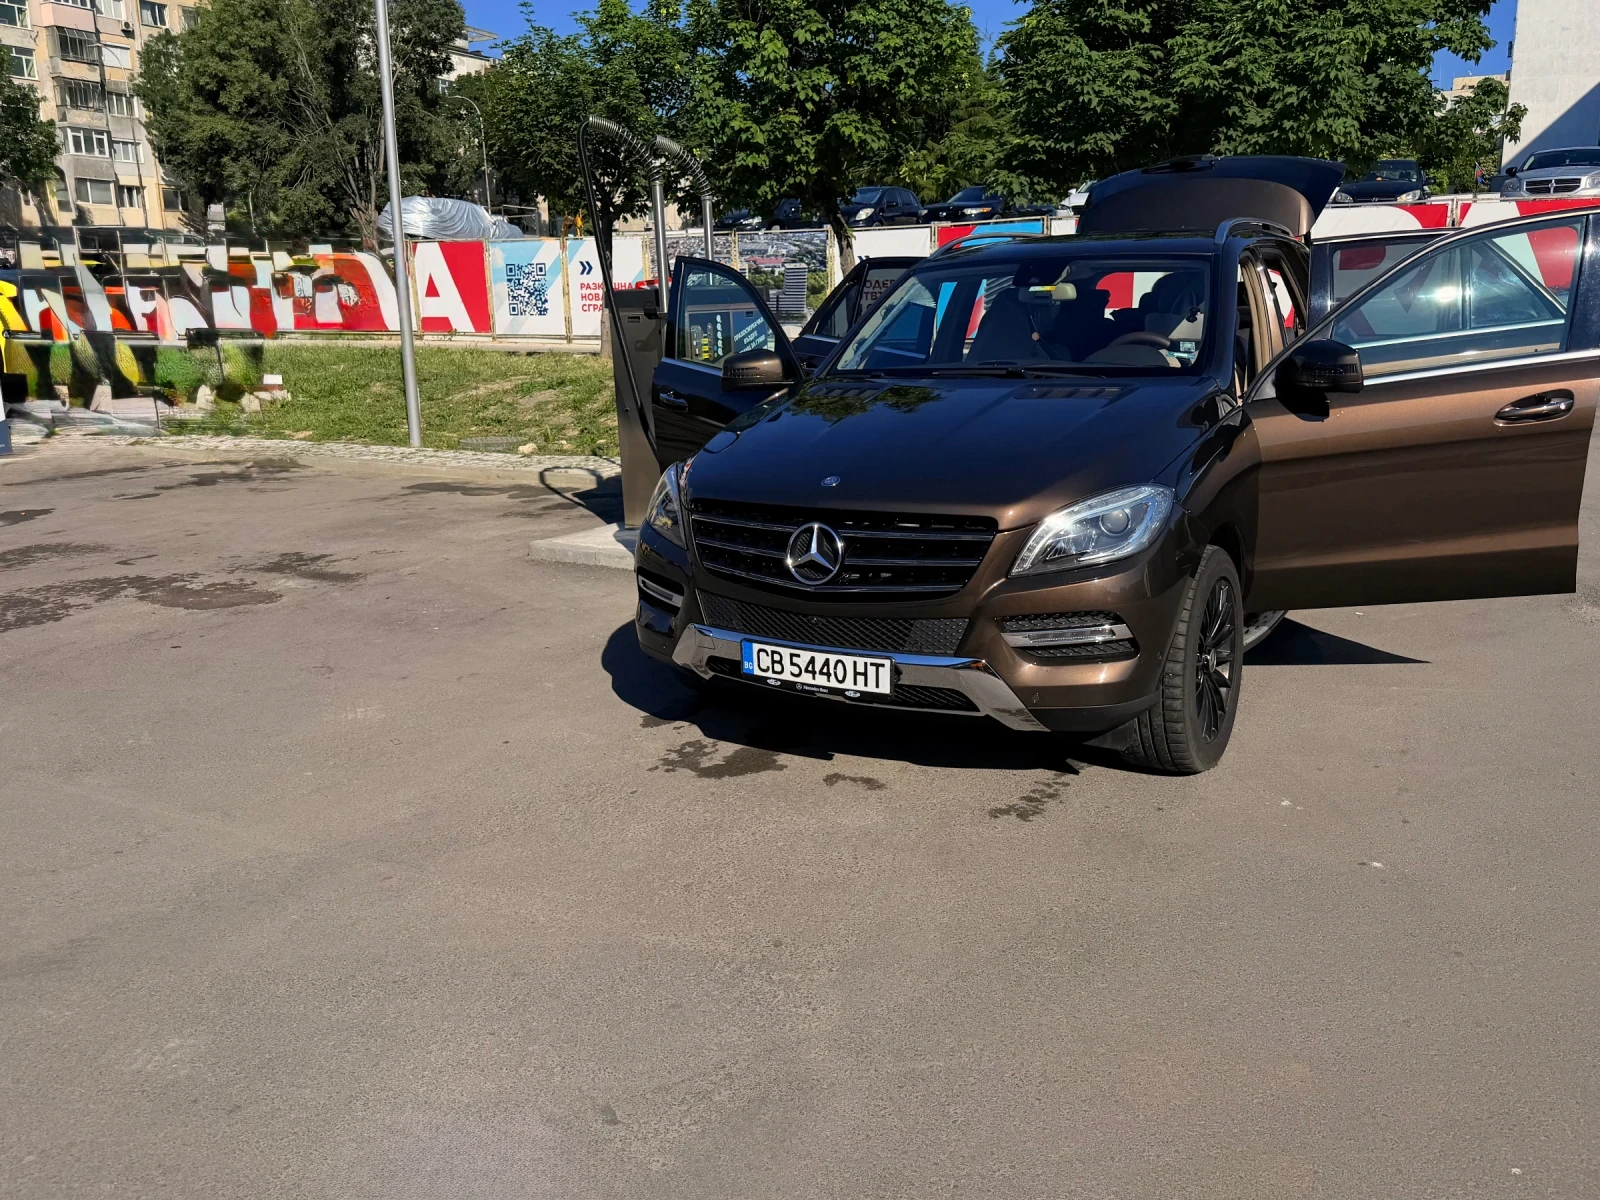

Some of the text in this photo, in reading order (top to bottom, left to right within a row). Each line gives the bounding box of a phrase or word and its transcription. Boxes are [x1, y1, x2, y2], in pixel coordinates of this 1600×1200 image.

[580, 282, 633, 291] РАЗКШНА
[581, 303, 604, 312] СГРА
[744, 648, 885, 689] BG CB 5440 HT
